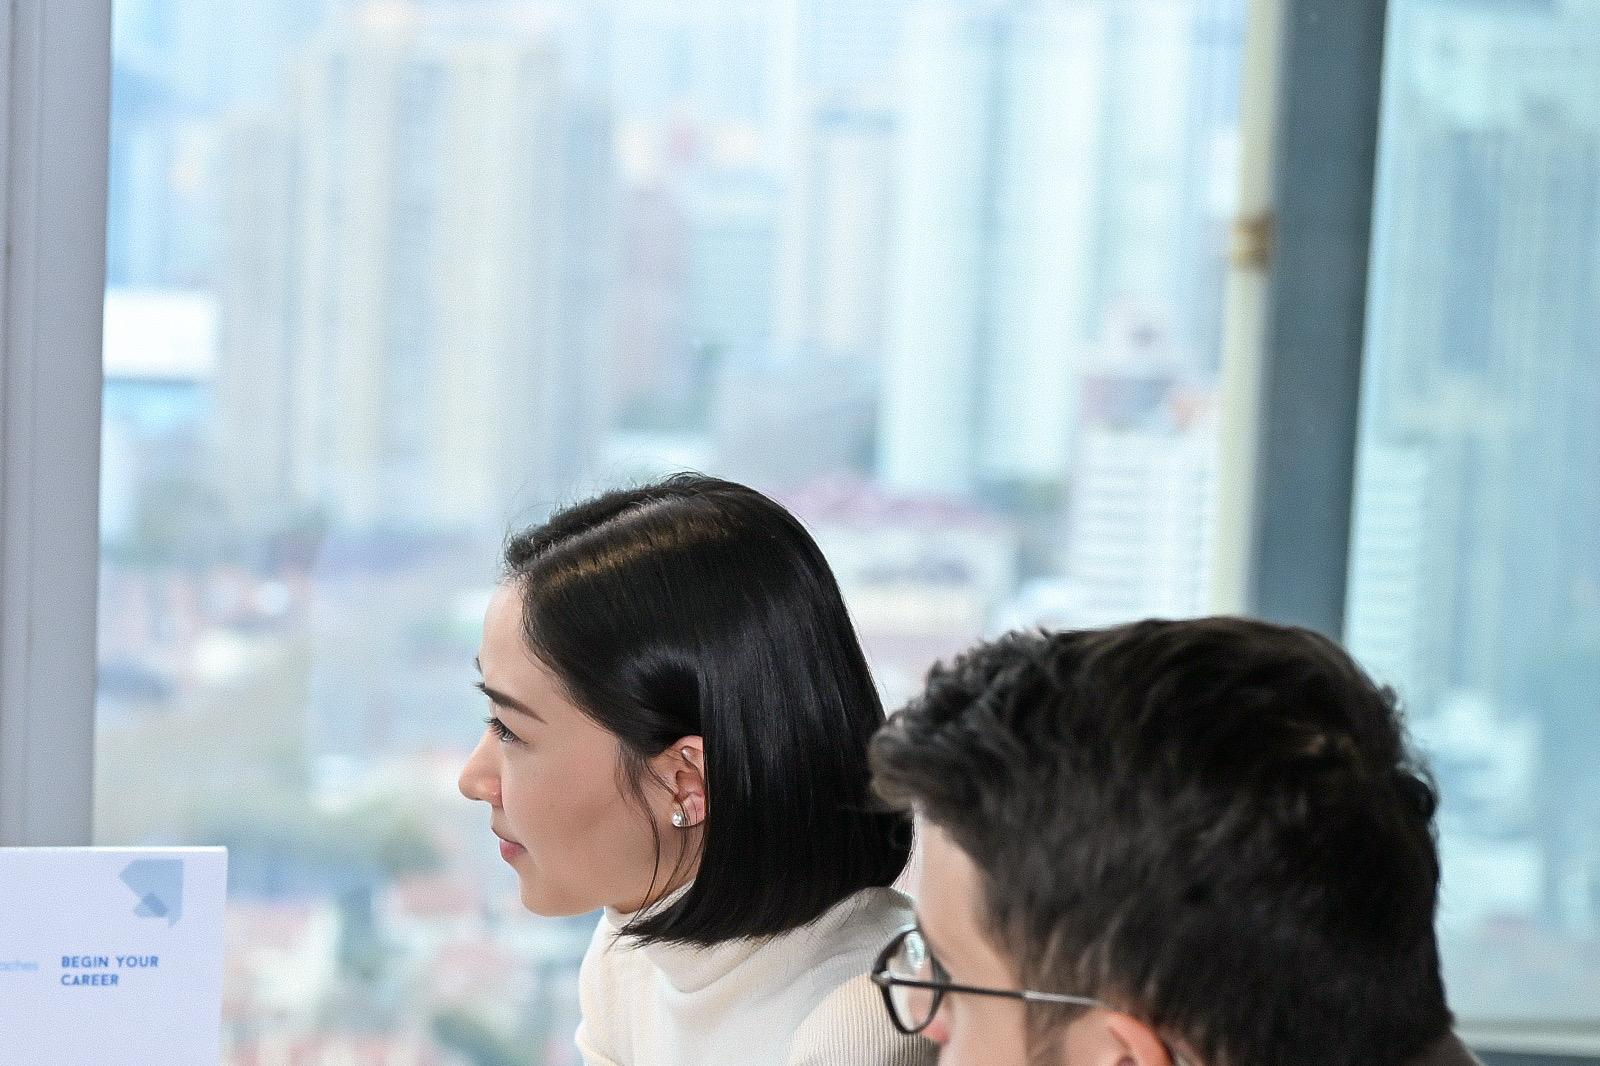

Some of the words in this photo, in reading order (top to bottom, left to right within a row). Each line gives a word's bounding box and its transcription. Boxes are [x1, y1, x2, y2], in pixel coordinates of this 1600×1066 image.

[61, 955, 109, 969] BEGIN
[116, 955, 160, 968] YOUR
[60, 973, 120, 987] CAREER
